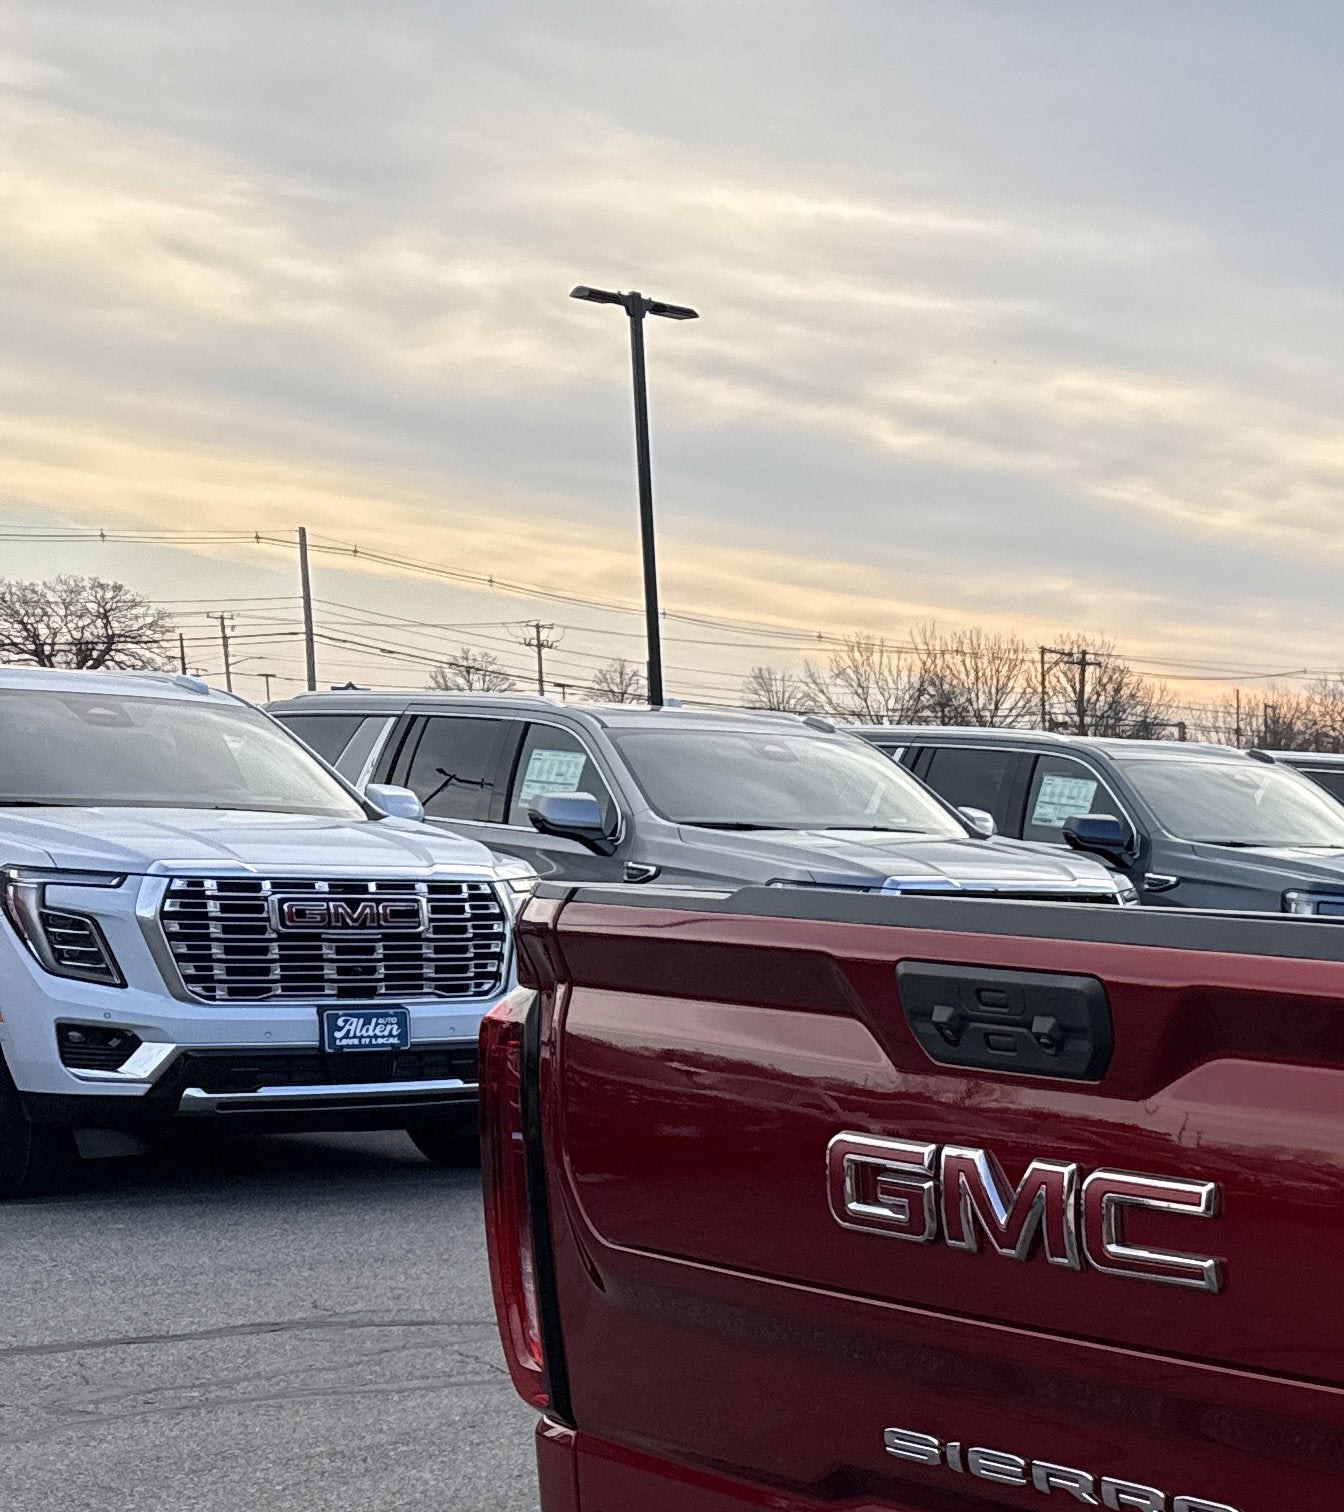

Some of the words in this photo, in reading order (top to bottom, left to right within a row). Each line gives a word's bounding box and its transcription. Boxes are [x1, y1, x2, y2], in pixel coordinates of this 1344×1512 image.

[283, 901, 420, 927] GMC
[333, 1016, 402, 1038] Alden
[335, 1038, 360, 1046] LOVE
[371, 1037, 401, 1045] LOCAL
[826, 1130, 1223, 1294] GMC
